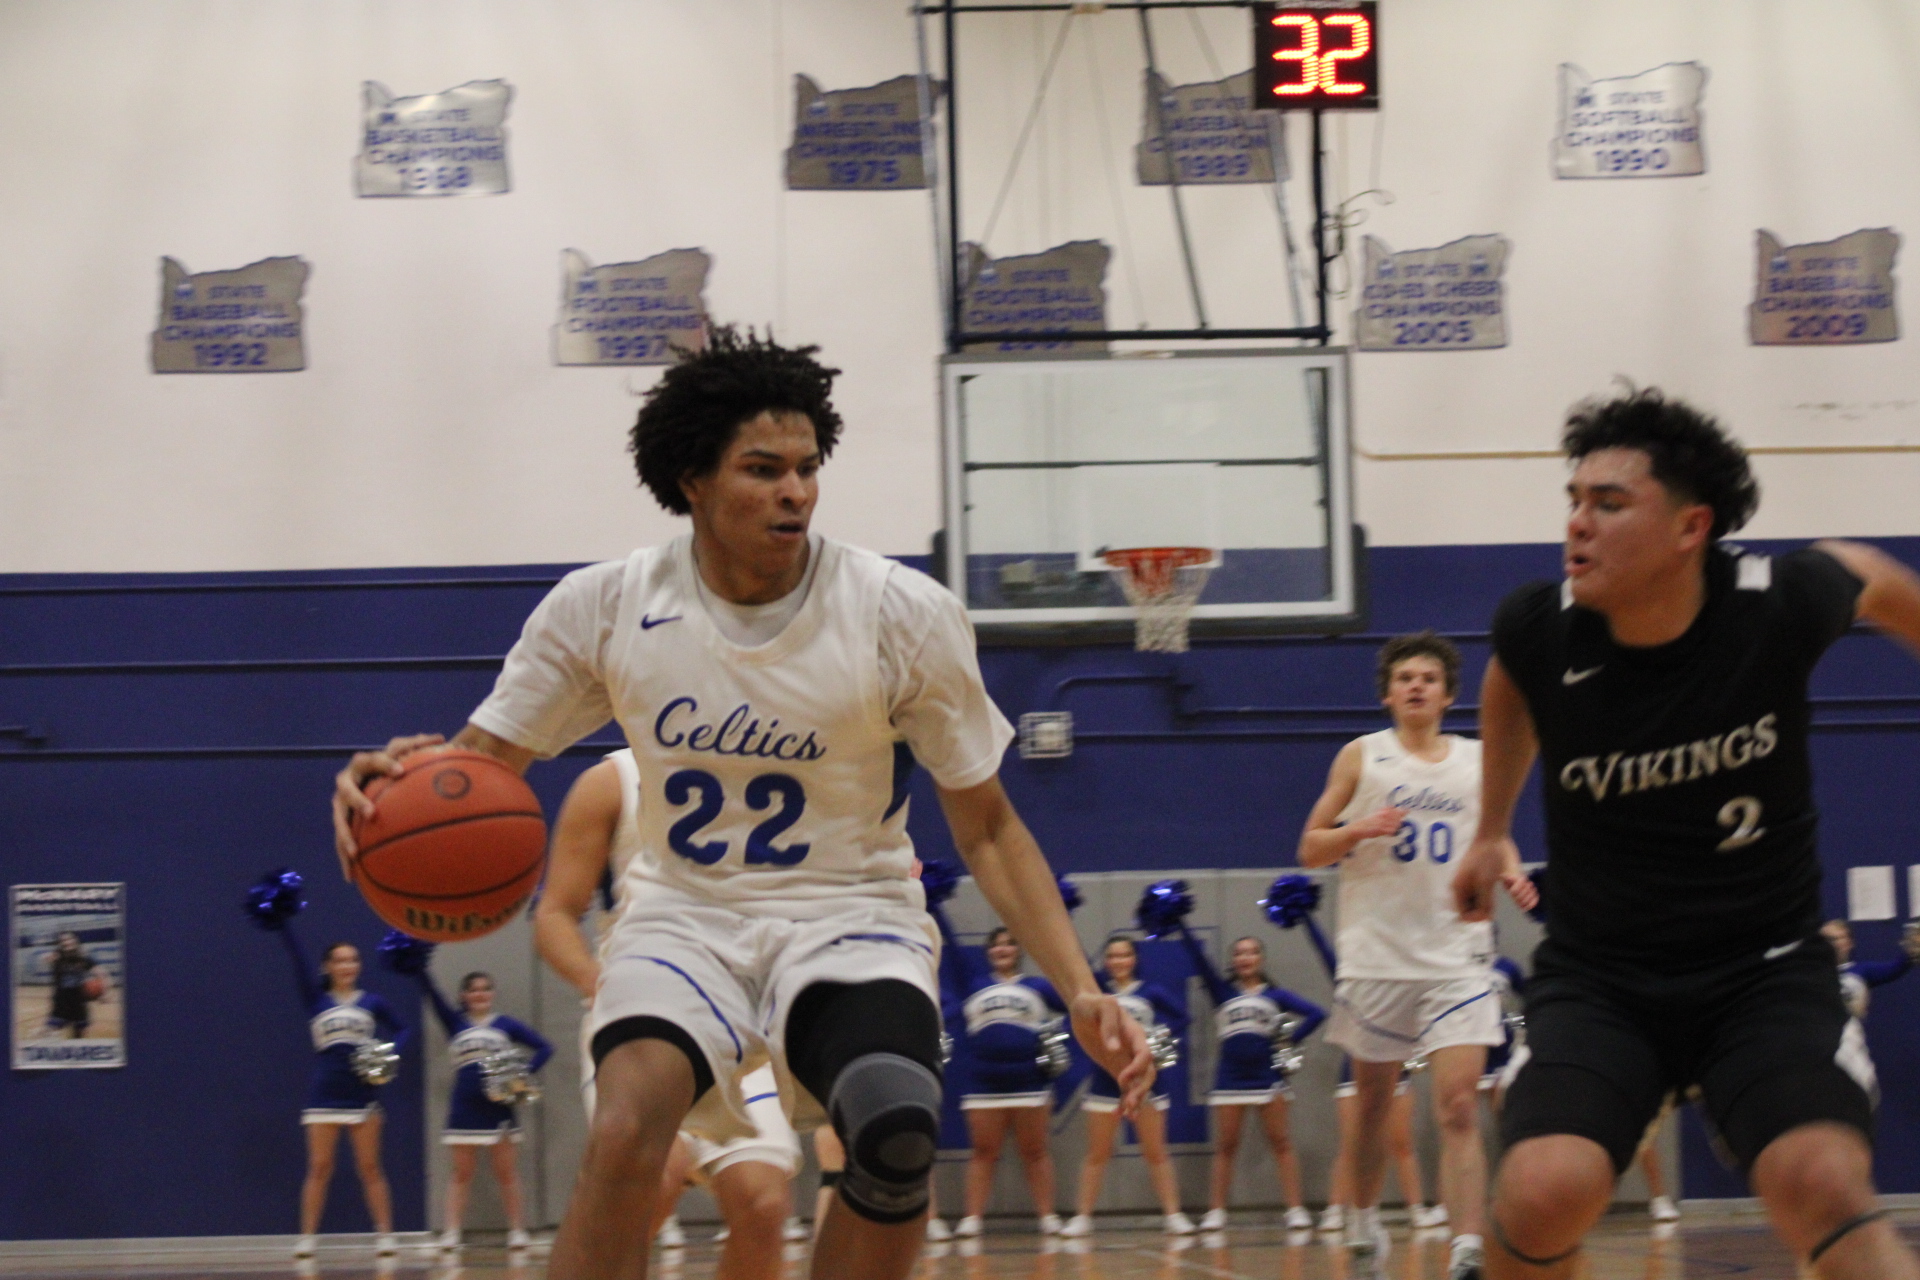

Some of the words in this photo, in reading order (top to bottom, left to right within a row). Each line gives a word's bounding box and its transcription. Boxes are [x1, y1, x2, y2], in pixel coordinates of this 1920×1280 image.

[1271, 13, 1370, 95] 32
[1609, 91, 1665, 105] STATE
[842, 103, 898, 117] STATE
[1573, 110, 1689, 127] SOFTBALL
[367, 127, 501, 145] BASKETBALL
[1564, 128, 1699, 148] CHAMPIONS
[368, 145, 502, 165] CHAMPIONS
[798, 141, 922, 159] CHAMPION
[1594, 148, 1670, 171] 1990
[828, 160, 900, 183] 1975
[1178, 154, 1251, 178] 1989
[1404, 264, 1461, 278] STATE
[1803, 257, 1858, 271] STATE
[612, 277, 667, 291] STATE
[1013, 269, 1070, 283] STATE
[1769, 277, 1883, 293] BASEBALL
[209, 285, 267, 299] STATE
[974, 288, 1092, 305] FOOTBALL
[171, 304, 288, 321] BASEBALL
[574, 297, 692, 313] FOOTBALL
[1366, 301, 1500, 319] CHAMPIONS
[1759, 293, 1892, 313] CHAMPIONS
[569, 314, 701, 333] CHAMPIONS
[968, 305, 1102, 326] CHAMPIONS
[1787, 313, 1867, 338] 2009
[164, 322, 299, 341] CHAMPIONS
[1394, 321, 1473, 345] 2005
[194, 342, 268, 366] 1992
[598, 334, 669, 358] 1997
[654, 696, 827, 760] Celtics
[1560, 712, 1778, 801] VIKINGS
[1386, 784, 1466, 813] Celtics
[664, 769, 811, 866] 22
[1716, 795, 1767, 850] 2
[1391, 819, 1453, 865] 30
